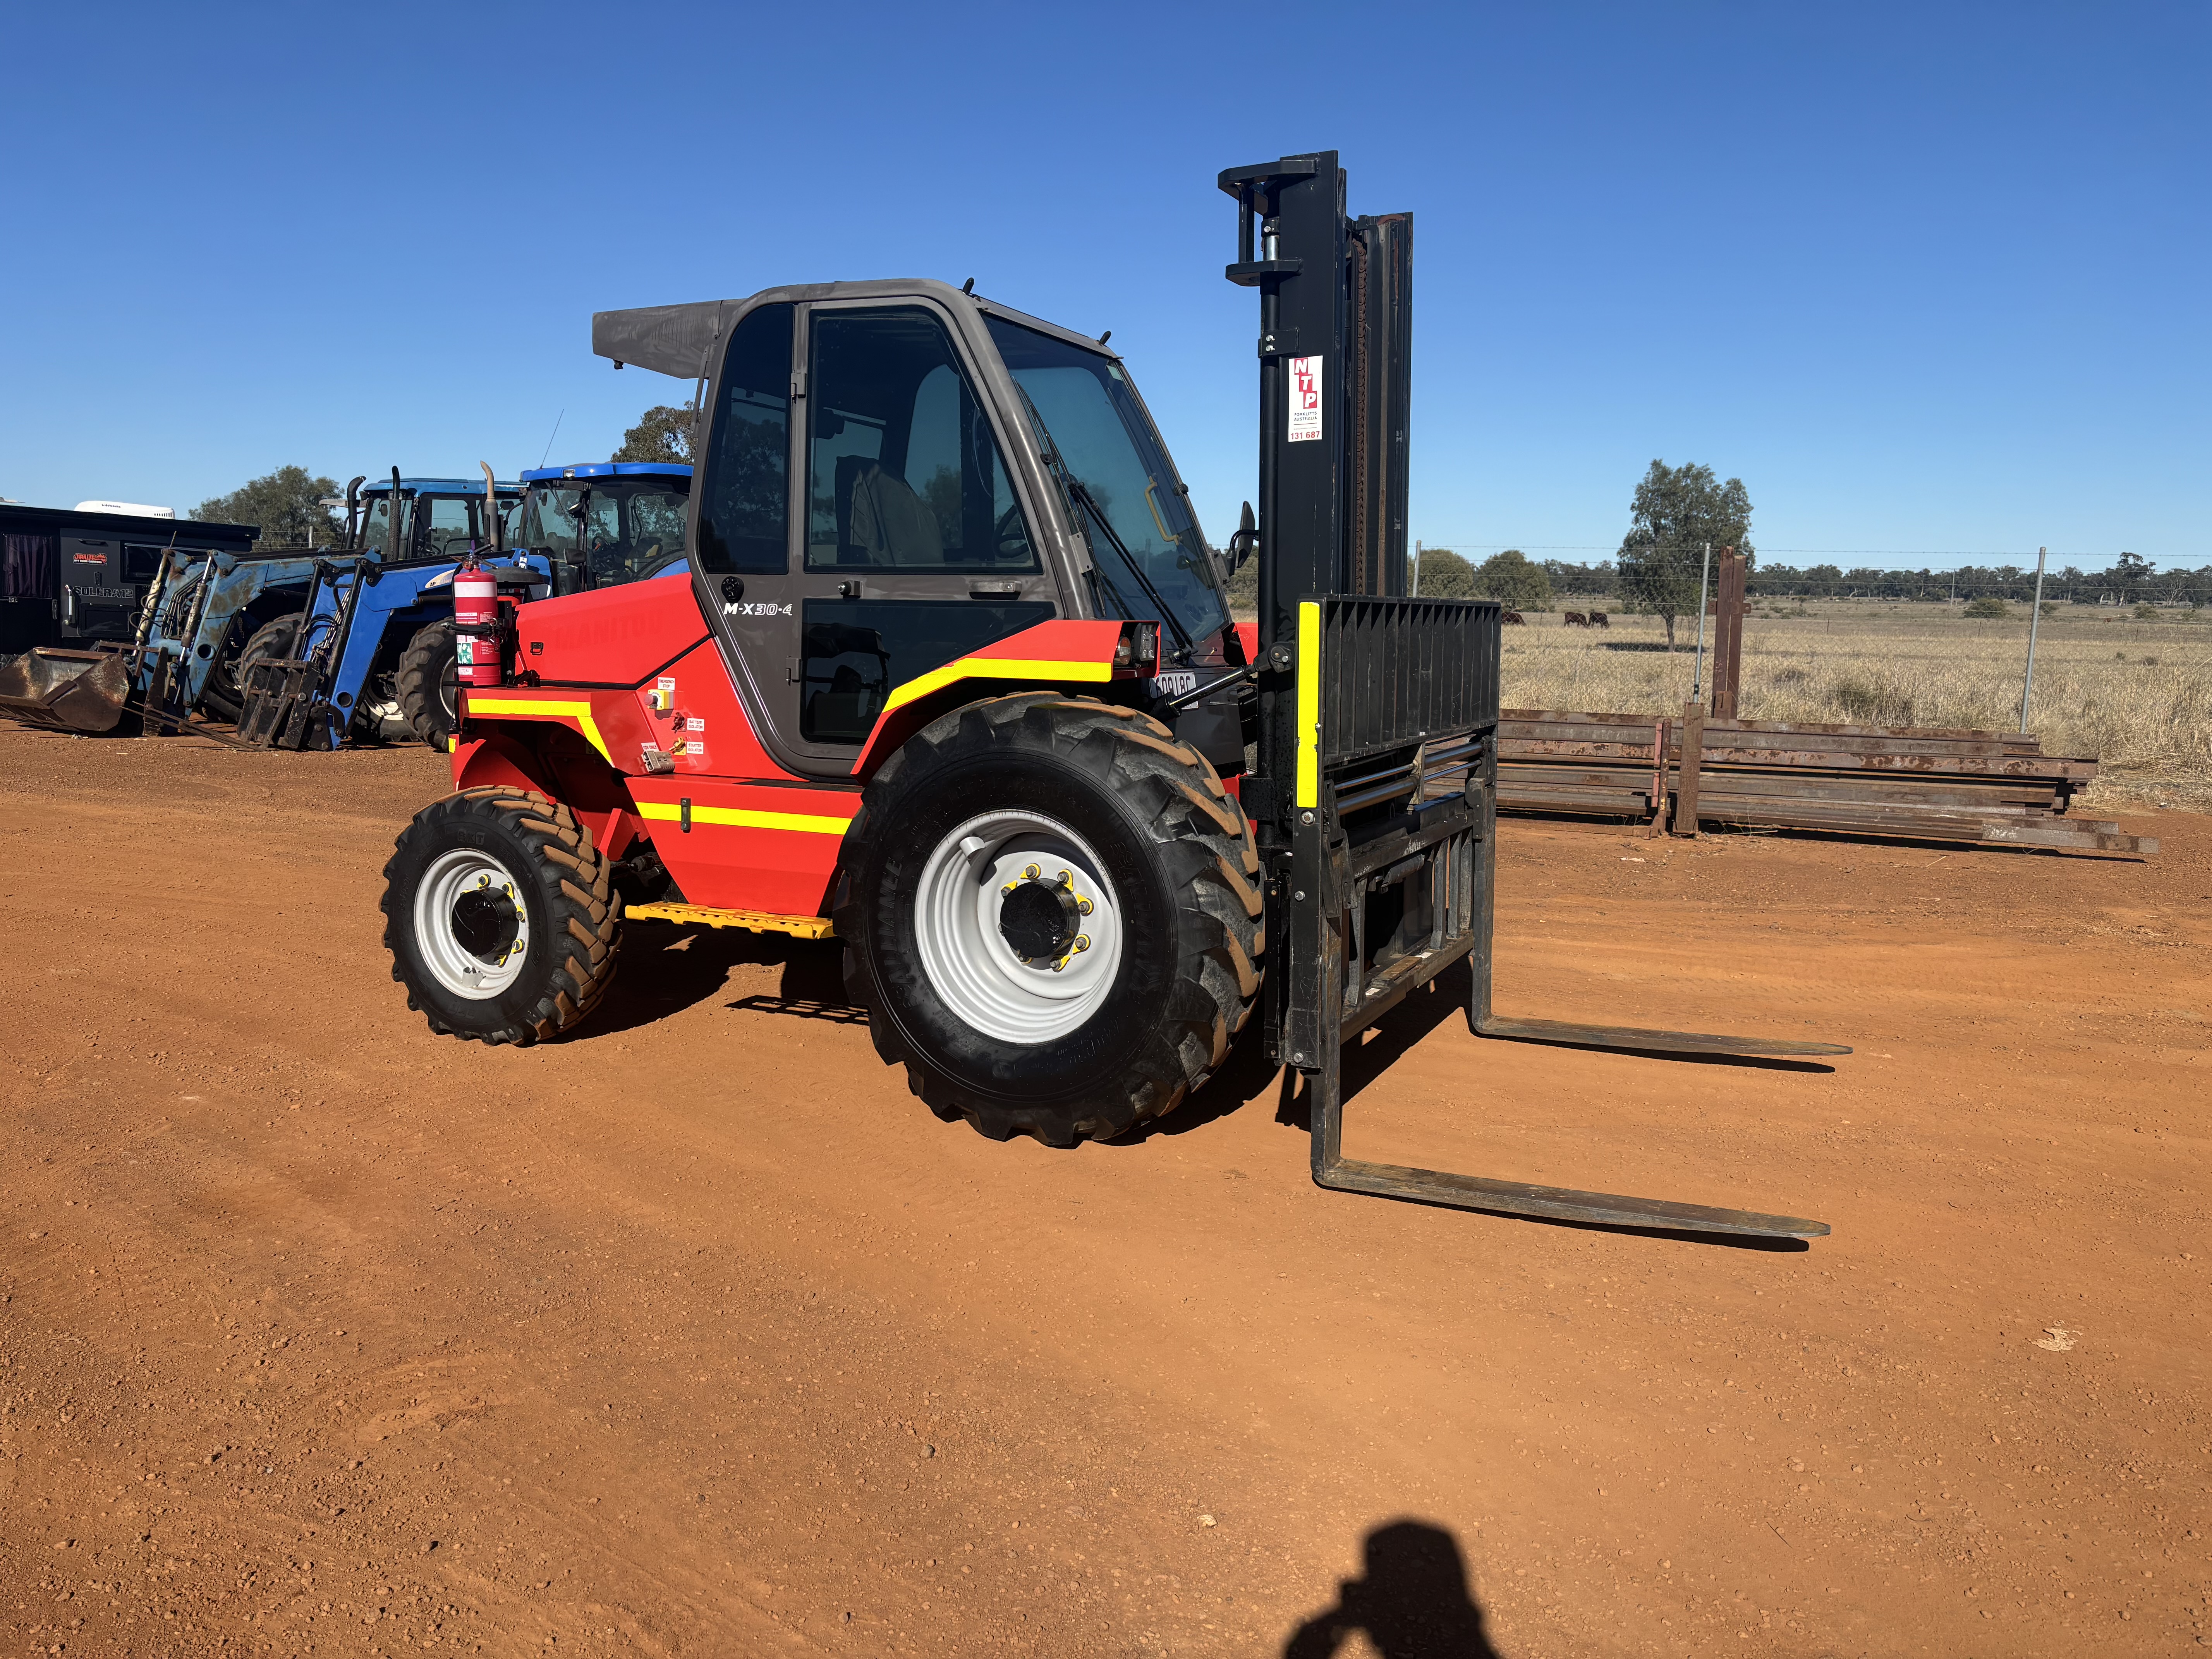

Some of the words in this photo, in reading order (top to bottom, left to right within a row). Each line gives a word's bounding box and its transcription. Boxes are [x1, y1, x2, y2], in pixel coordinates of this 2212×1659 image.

[1295, 359, 1316, 408] NTP
[1306, 431, 1320, 439] 687
[878, 857, 913, 983] ALLIANCE
